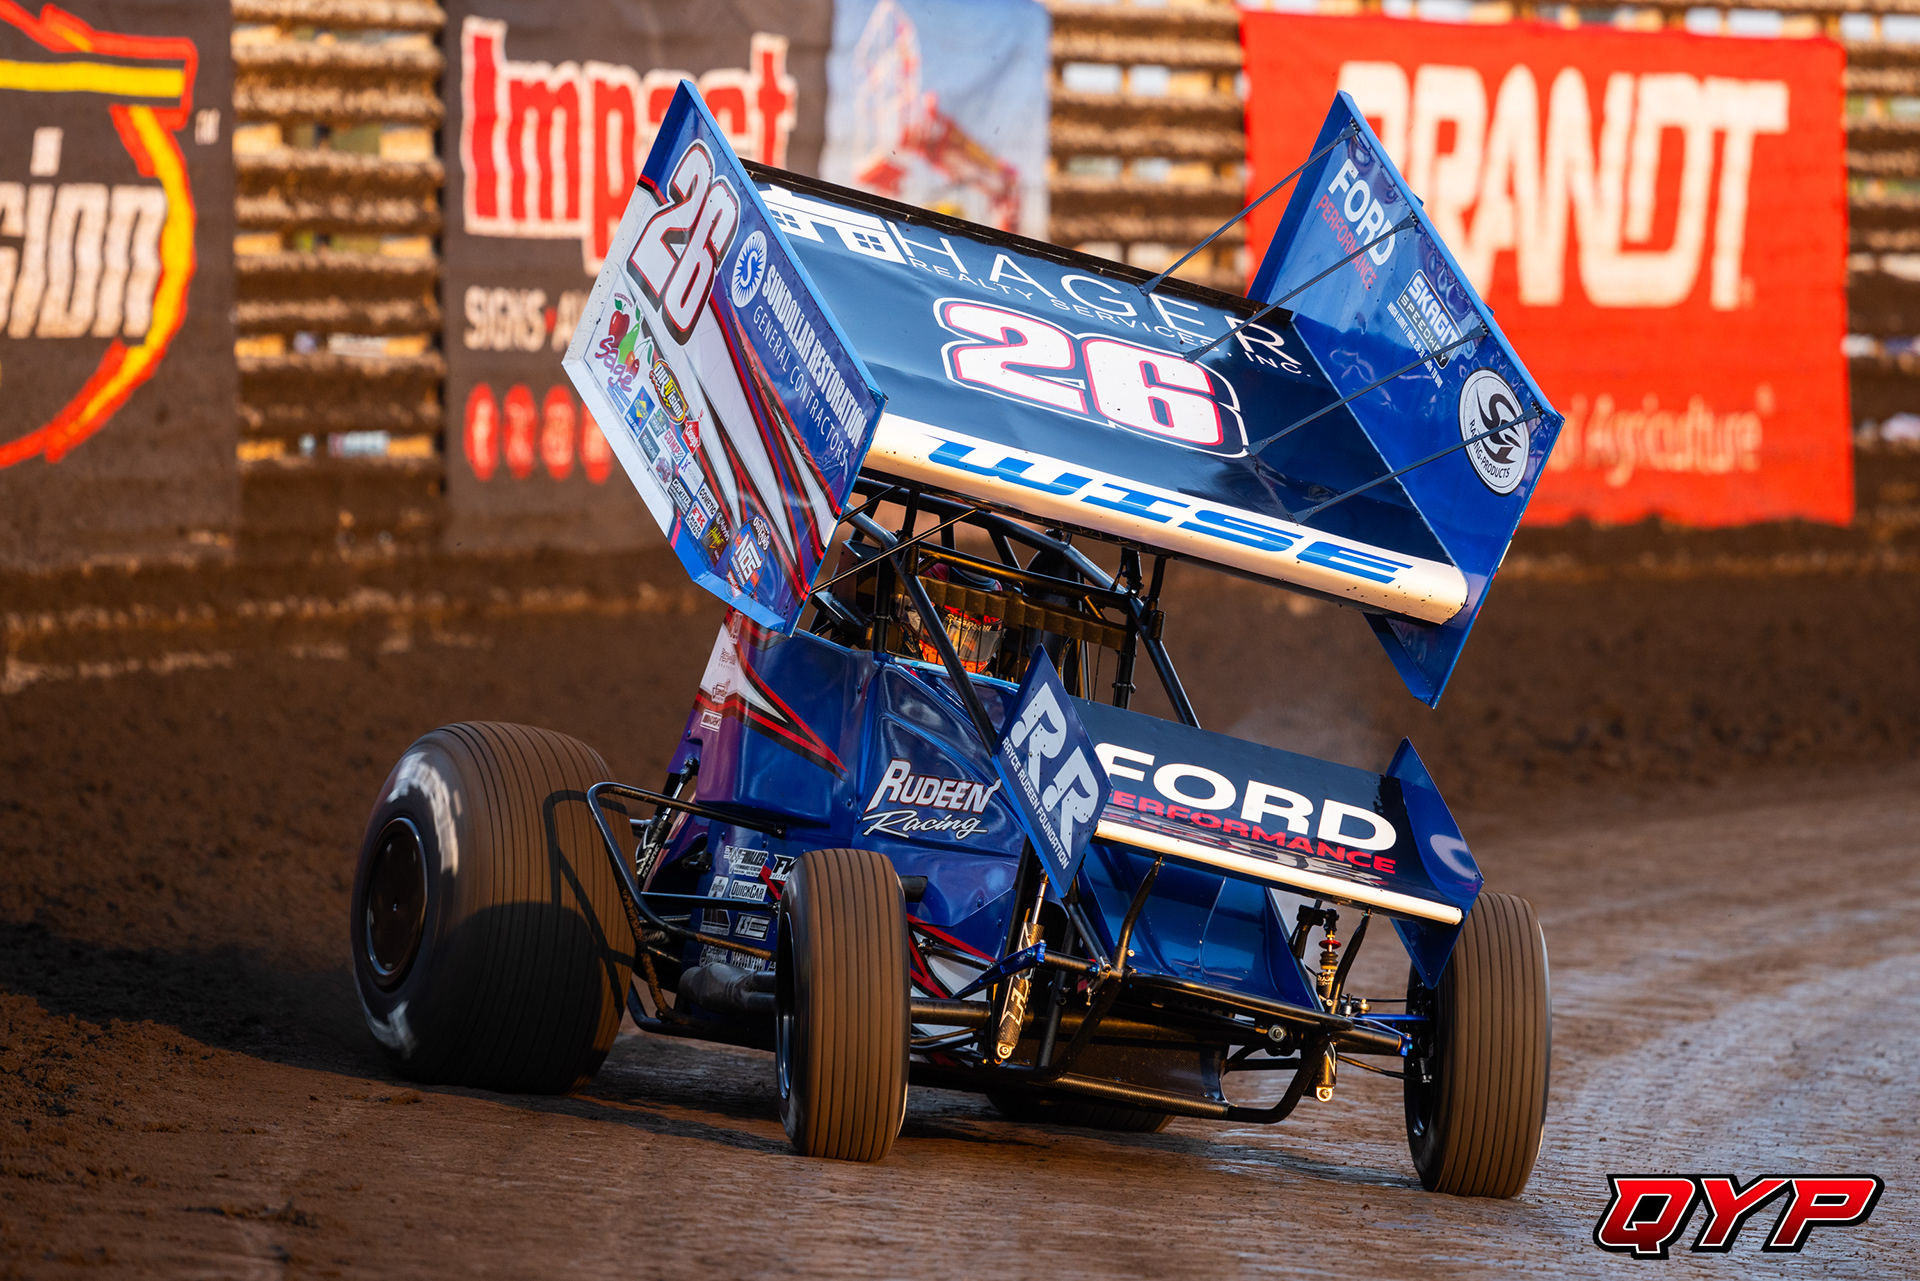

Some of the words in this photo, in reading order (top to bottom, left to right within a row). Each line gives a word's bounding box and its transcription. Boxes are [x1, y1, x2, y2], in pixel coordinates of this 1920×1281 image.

[461, 16, 799, 277] Impct
[626, 138, 741, 346] 26
[1315, 193, 1378, 292] PERFORMANCE
[1328, 158, 1396, 267] FORD
[888, 221, 1302, 366] HAGER
[910, 258, 1034, 300] REALTY
[1244, 351, 1312, 378] INC.
[1407, 274, 1458, 348] SKAGIT
[595, 336, 633, 393] Sage
[752, 305, 791, 373] GENERAL
[788, 365, 850, 467] CONTRACTORS
[938, 299, 1240, 454] 26
[664, 430, 680, 454] COMP
[1468, 418, 1511, 479] RAING-PRODUCTS
[673, 478, 692, 509] CAPITOL
[692, 506, 706, 527] FK
[699, 488, 716, 515] COMETIC
[922, 434, 1413, 584] WISE
[734, 532, 763, 581] NOS
[865, 758, 1002, 814] RUDEEN
[1002, 737, 1020, 774] RAYCE
[1016, 769, 1040, 813] RUDEEN
[1036, 804, 1069, 870] FOUNDATION
[1011, 682, 1099, 858] RR
[1094, 742, 1397, 851] FORD
[863, 810, 988, 840] Racing
[1108, 790, 1396, 875] ERFORMANCE
